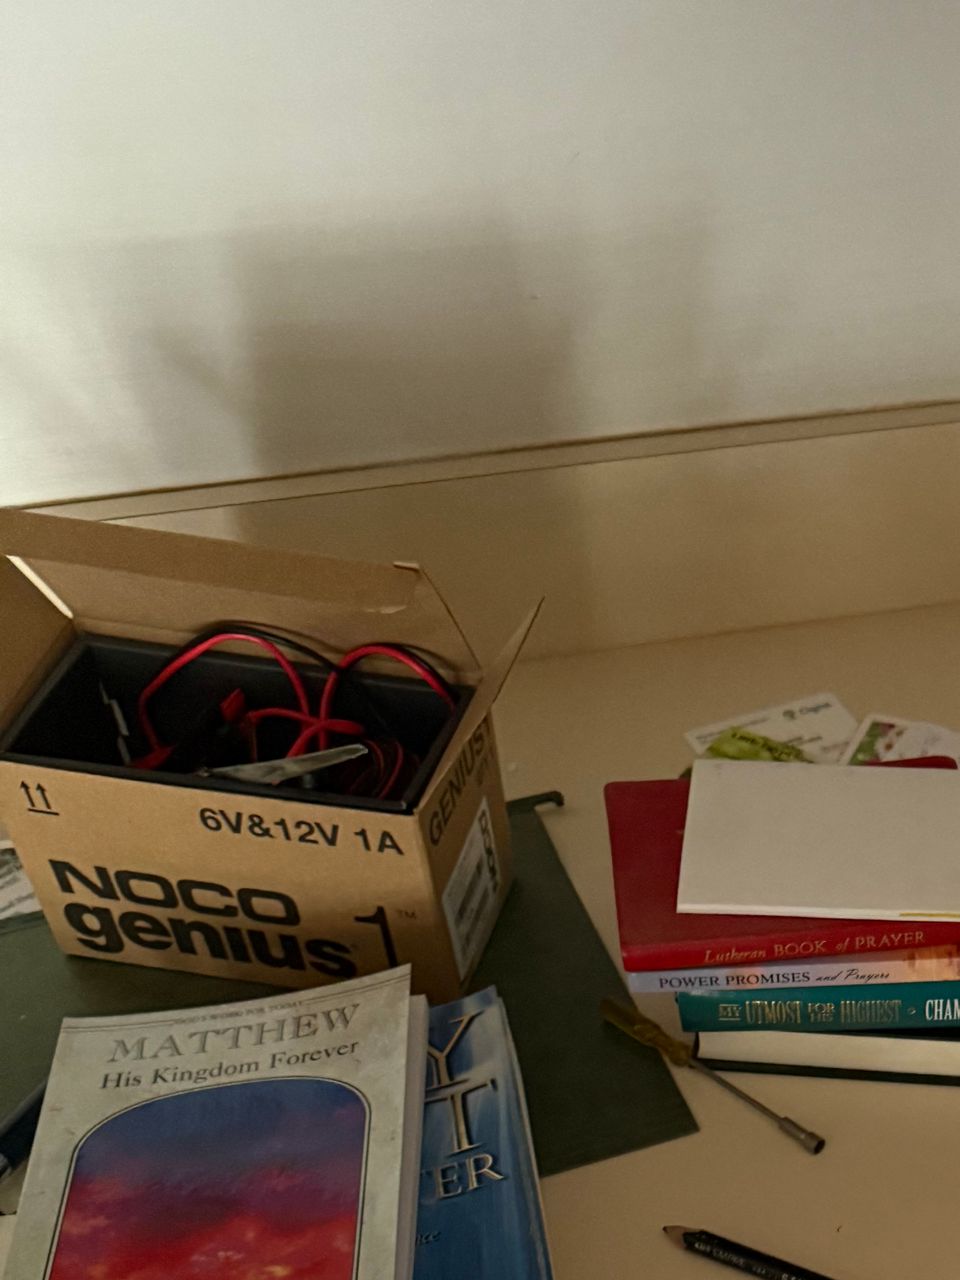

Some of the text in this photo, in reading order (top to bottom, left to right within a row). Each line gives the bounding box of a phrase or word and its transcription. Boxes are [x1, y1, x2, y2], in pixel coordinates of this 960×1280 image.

[200, 807, 405, 855] 6V&12V 1A
[48, 859, 301, 926] NOCO
[64, 903, 358, 978] genius
[704, 931, 926, 964] Lutheran BOOK of PRAYER
[659, 967, 891, 989] POWER PROMISES and Prayers
[107, 1003, 361, 1064] MATTHEW
[745, 1000, 801, 1024] UTMOST
[99, 1042, 361, 1091] His Kingdom Forever
